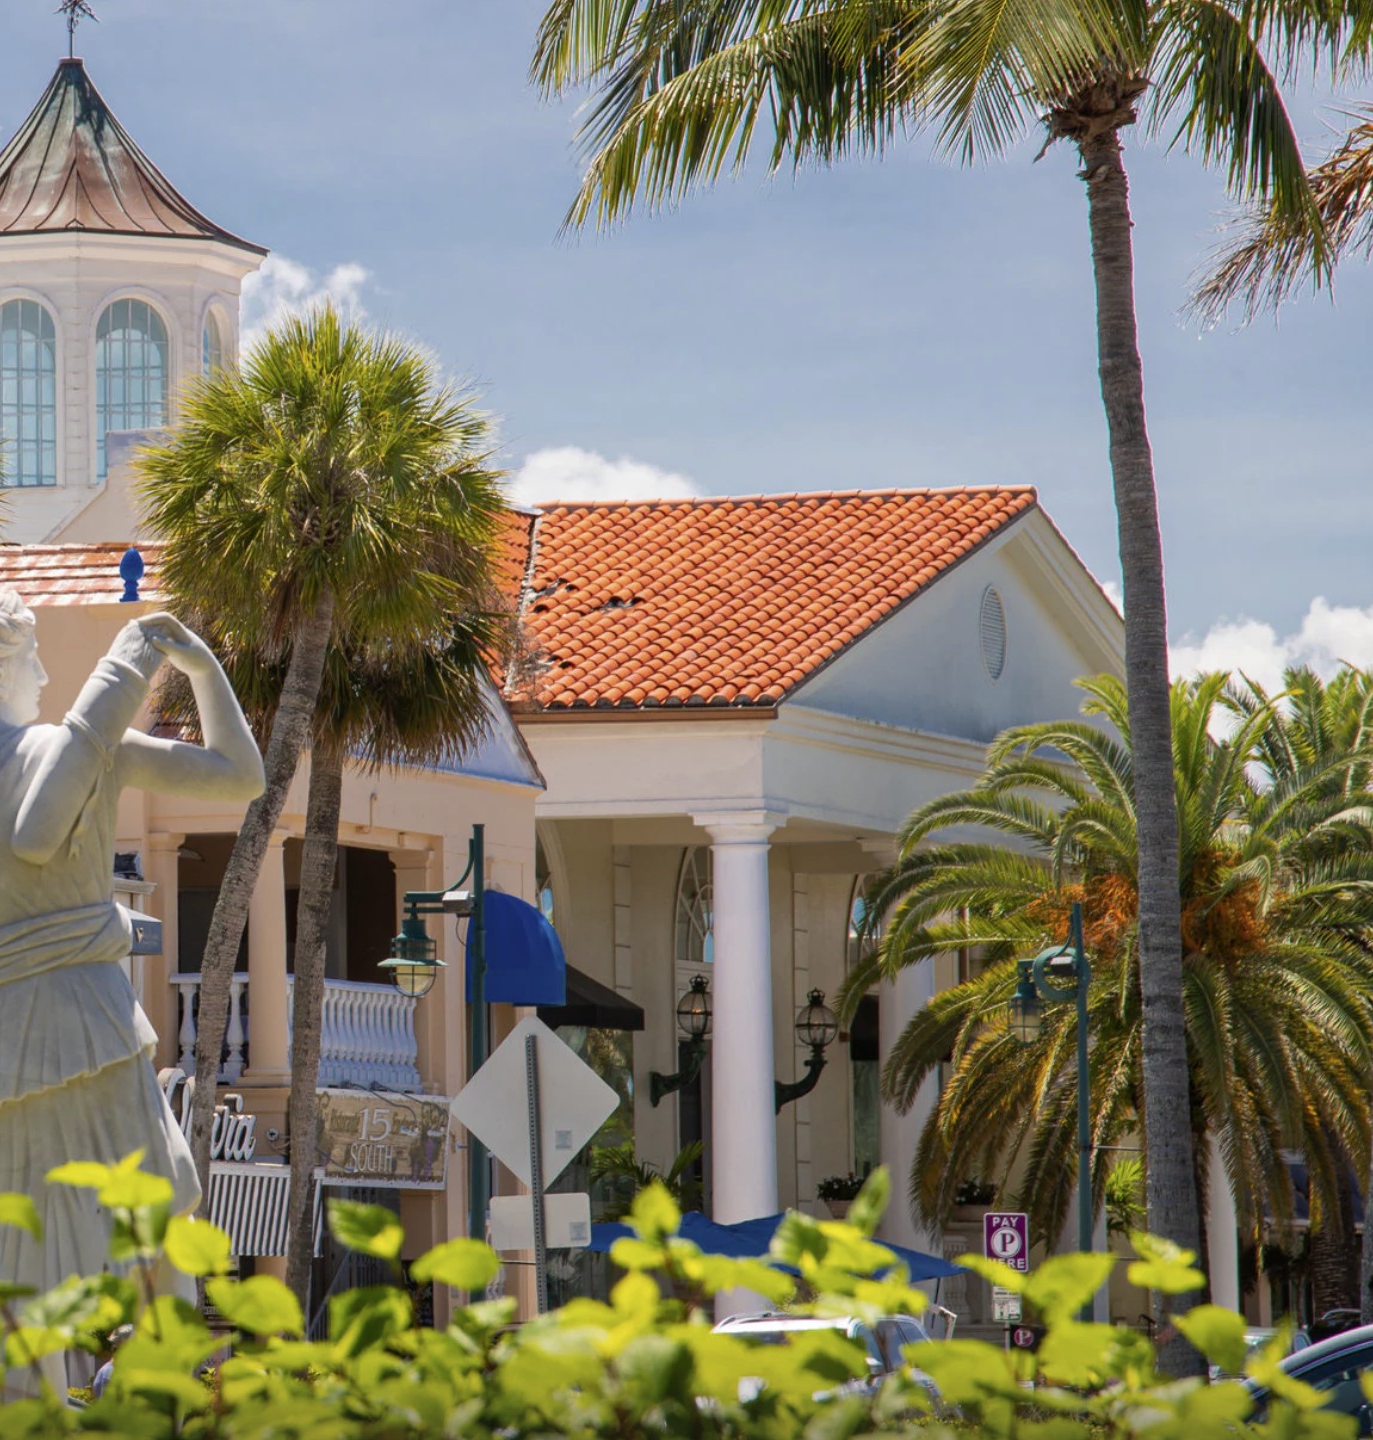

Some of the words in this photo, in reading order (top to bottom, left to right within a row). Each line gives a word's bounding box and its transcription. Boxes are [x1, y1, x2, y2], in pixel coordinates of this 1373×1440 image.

[358, 1108, 392, 1141] 15
[350, 1143, 393, 1173] SOUTH
[992, 1217, 1019, 1227] PAY
[1000, 1233, 1016, 1252] P
